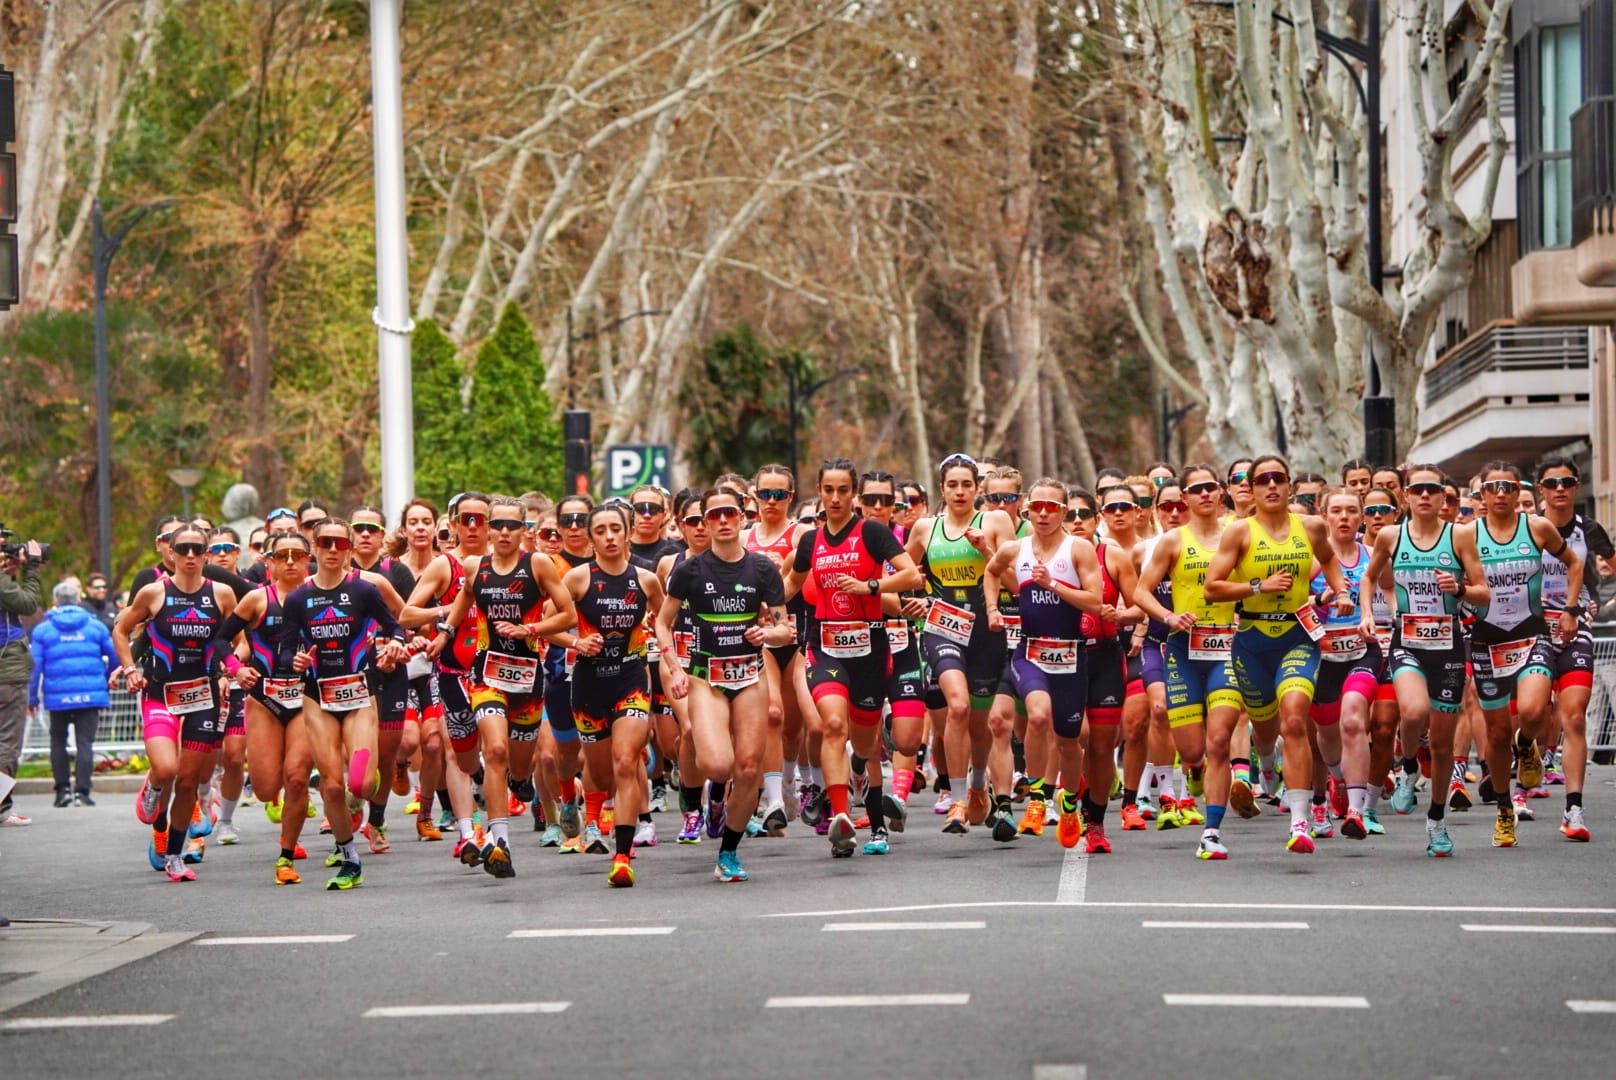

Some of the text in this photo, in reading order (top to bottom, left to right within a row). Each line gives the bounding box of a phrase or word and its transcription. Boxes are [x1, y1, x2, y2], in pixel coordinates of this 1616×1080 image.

[611, 450, 642, 490] P
[940, 566, 976, 582] AULINAS
[1408, 582, 1442, 596] PEIRATS
[712, 595, 746, 612] VIÑARÁS
[487, 604, 522, 619] ACOSTA
[600, 614, 635, 628] DEL POZO
[938, 615, 959, 631] 57A
[172, 624, 211, 638] NAVARRO
[310, 623, 350, 639] REIMONDO
[1416, 628, 1438, 638] 52B
[834, 635, 857, 646] 58A
[1203, 638, 1225, 649] 60A
[1331, 639, 1354, 651] 51C
[1040, 652, 1063, 663] 64A
[498, 668, 522, 681] 53C
[723, 667, 745, 680] 61J
[179, 692, 200, 703] 55F
[278, 688, 299, 699] 55G
[335, 688, 354, 700] 55I
